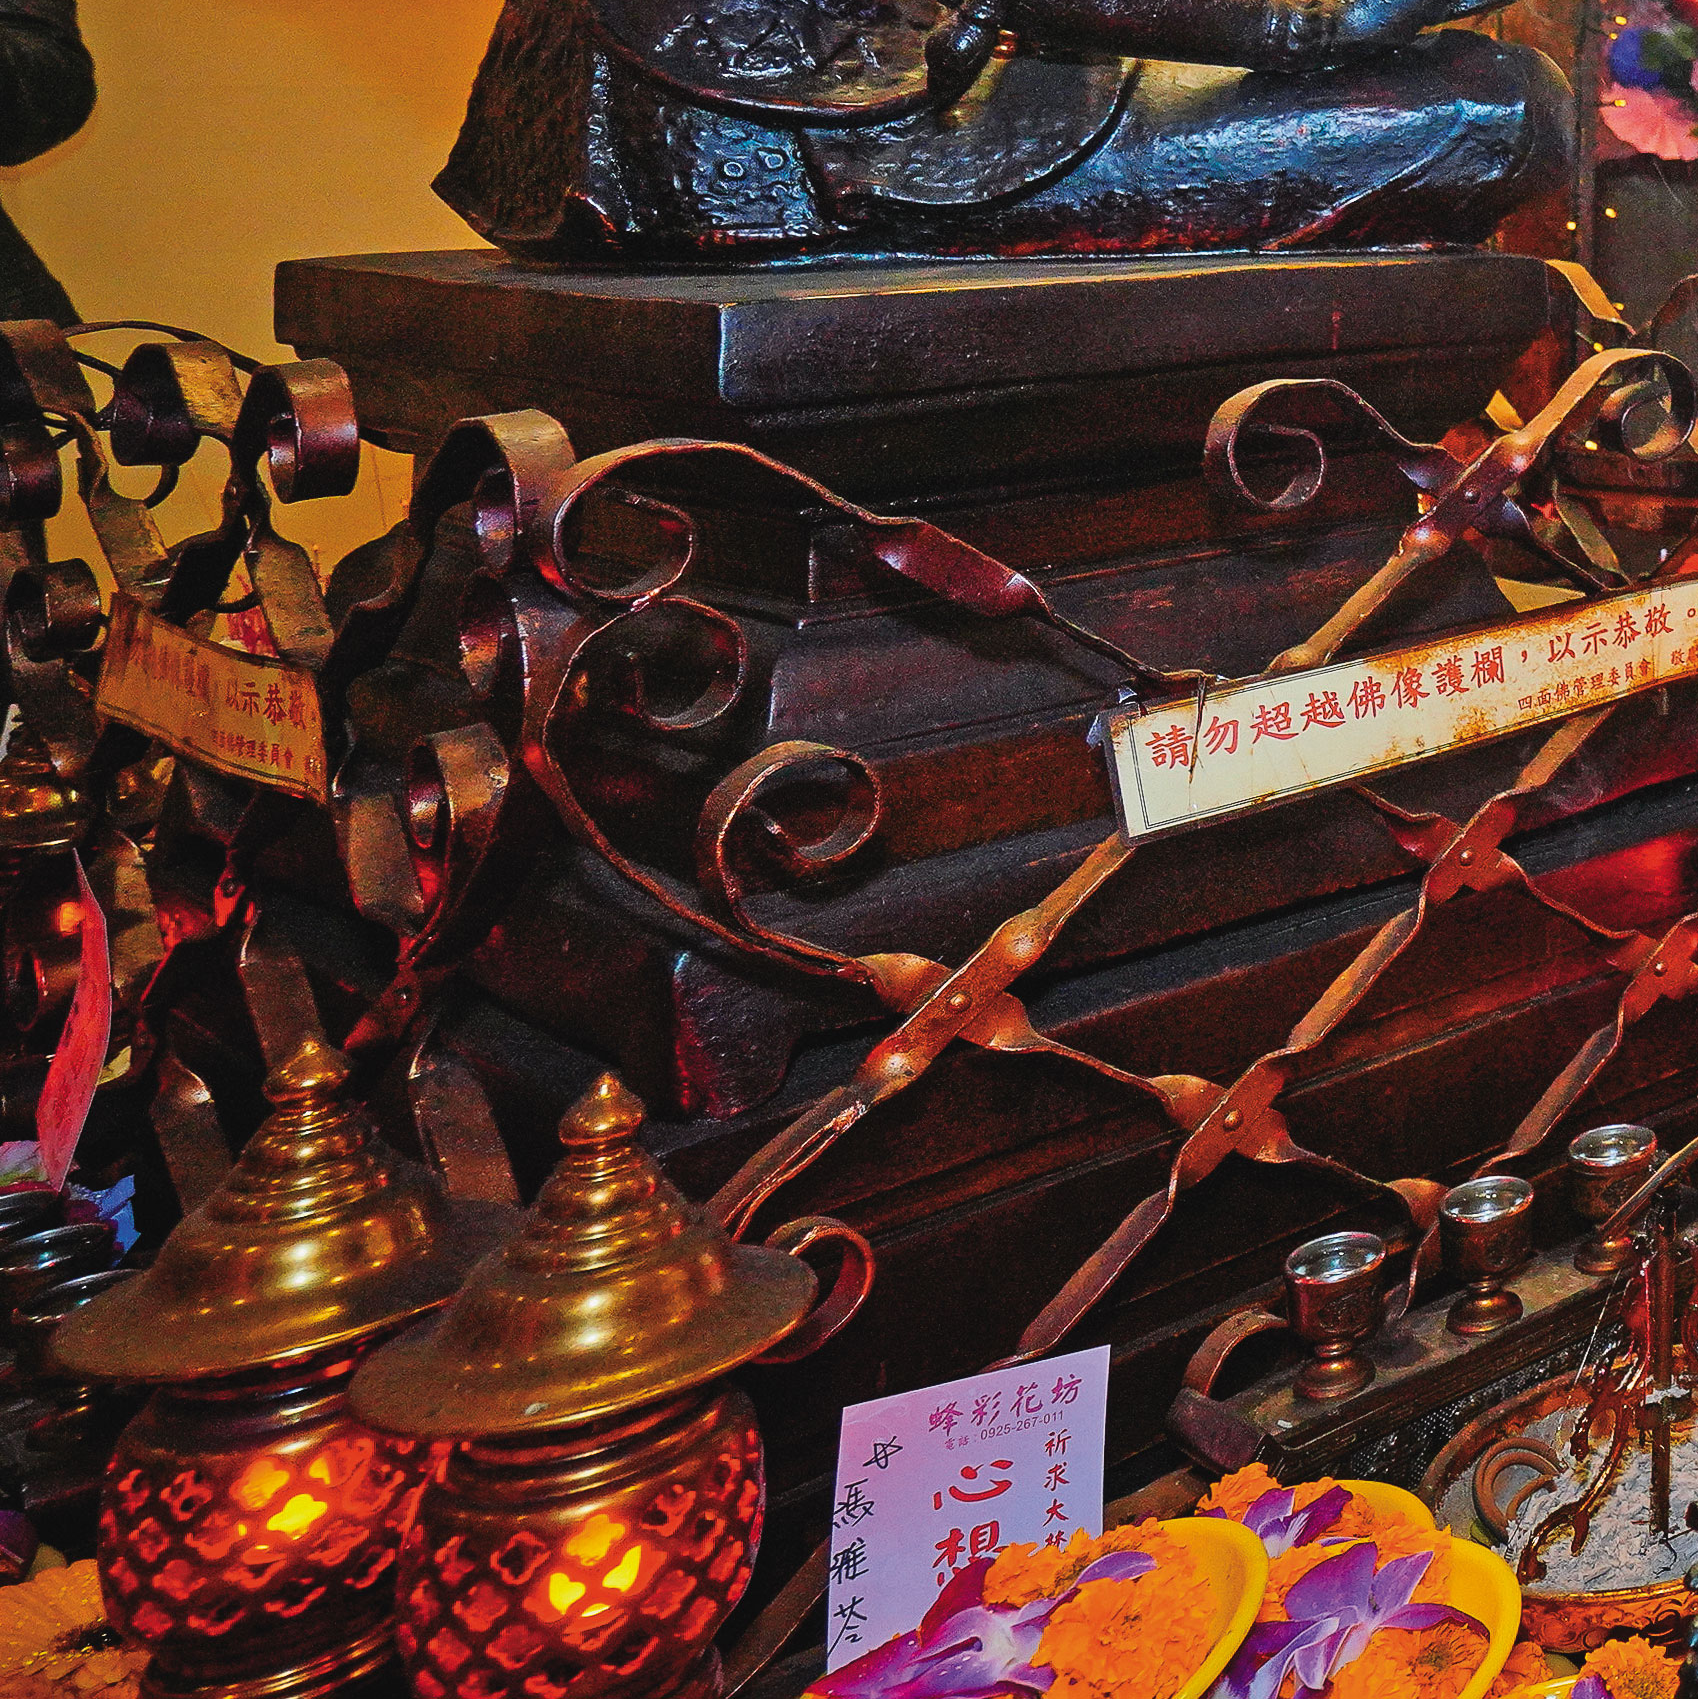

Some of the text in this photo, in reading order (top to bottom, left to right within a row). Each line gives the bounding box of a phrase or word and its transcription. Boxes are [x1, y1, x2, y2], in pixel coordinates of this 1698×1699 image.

[1517, 657, 1652, 712] 四面佛管理委員會
[928, 1373, 1084, 1437] 蜂彩花坊
